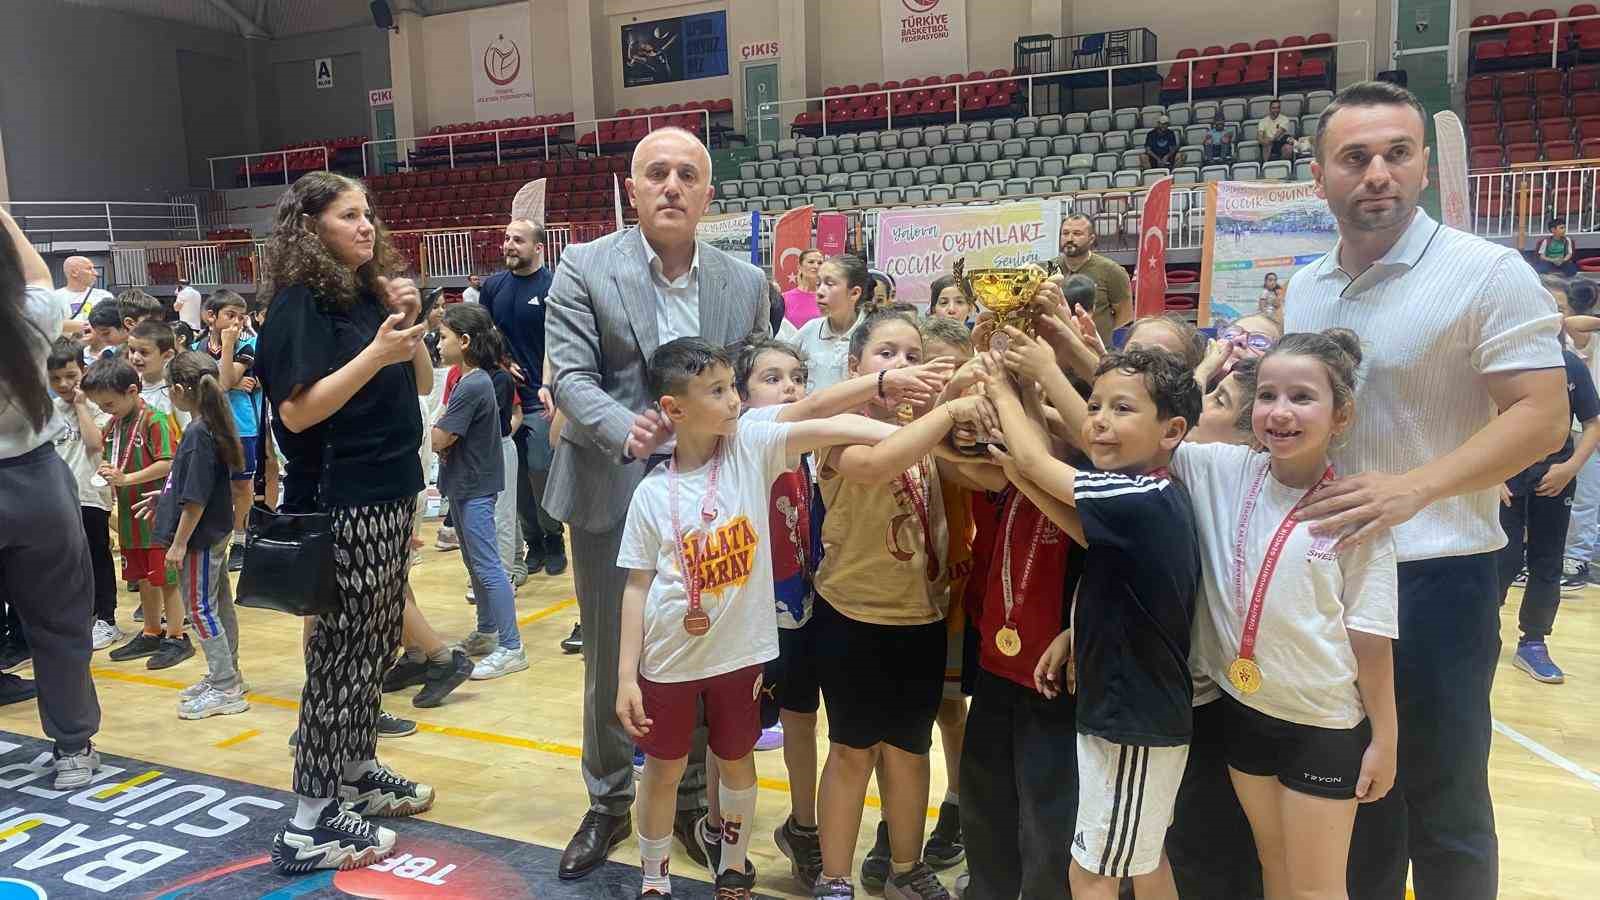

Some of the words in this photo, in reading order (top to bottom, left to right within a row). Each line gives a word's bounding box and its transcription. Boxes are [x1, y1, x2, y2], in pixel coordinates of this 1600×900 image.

[901, 13, 948, 28] TÜRKİYE
[901, 24, 948, 37] BASKETBOL
[901, 32, 949, 43] FEDERASYONU
[742, 42, 779, 59] ÇIKIŞ
[318, 61, 330, 79] A
[371, 91, 392, 103] ÇIKI
[942, 222, 1047, 253] OYUNLARI
[1304, 772, 1342, 783] TRYON
[0, 807, 189, 893] BAS
[367, 853, 457, 885] TBF
